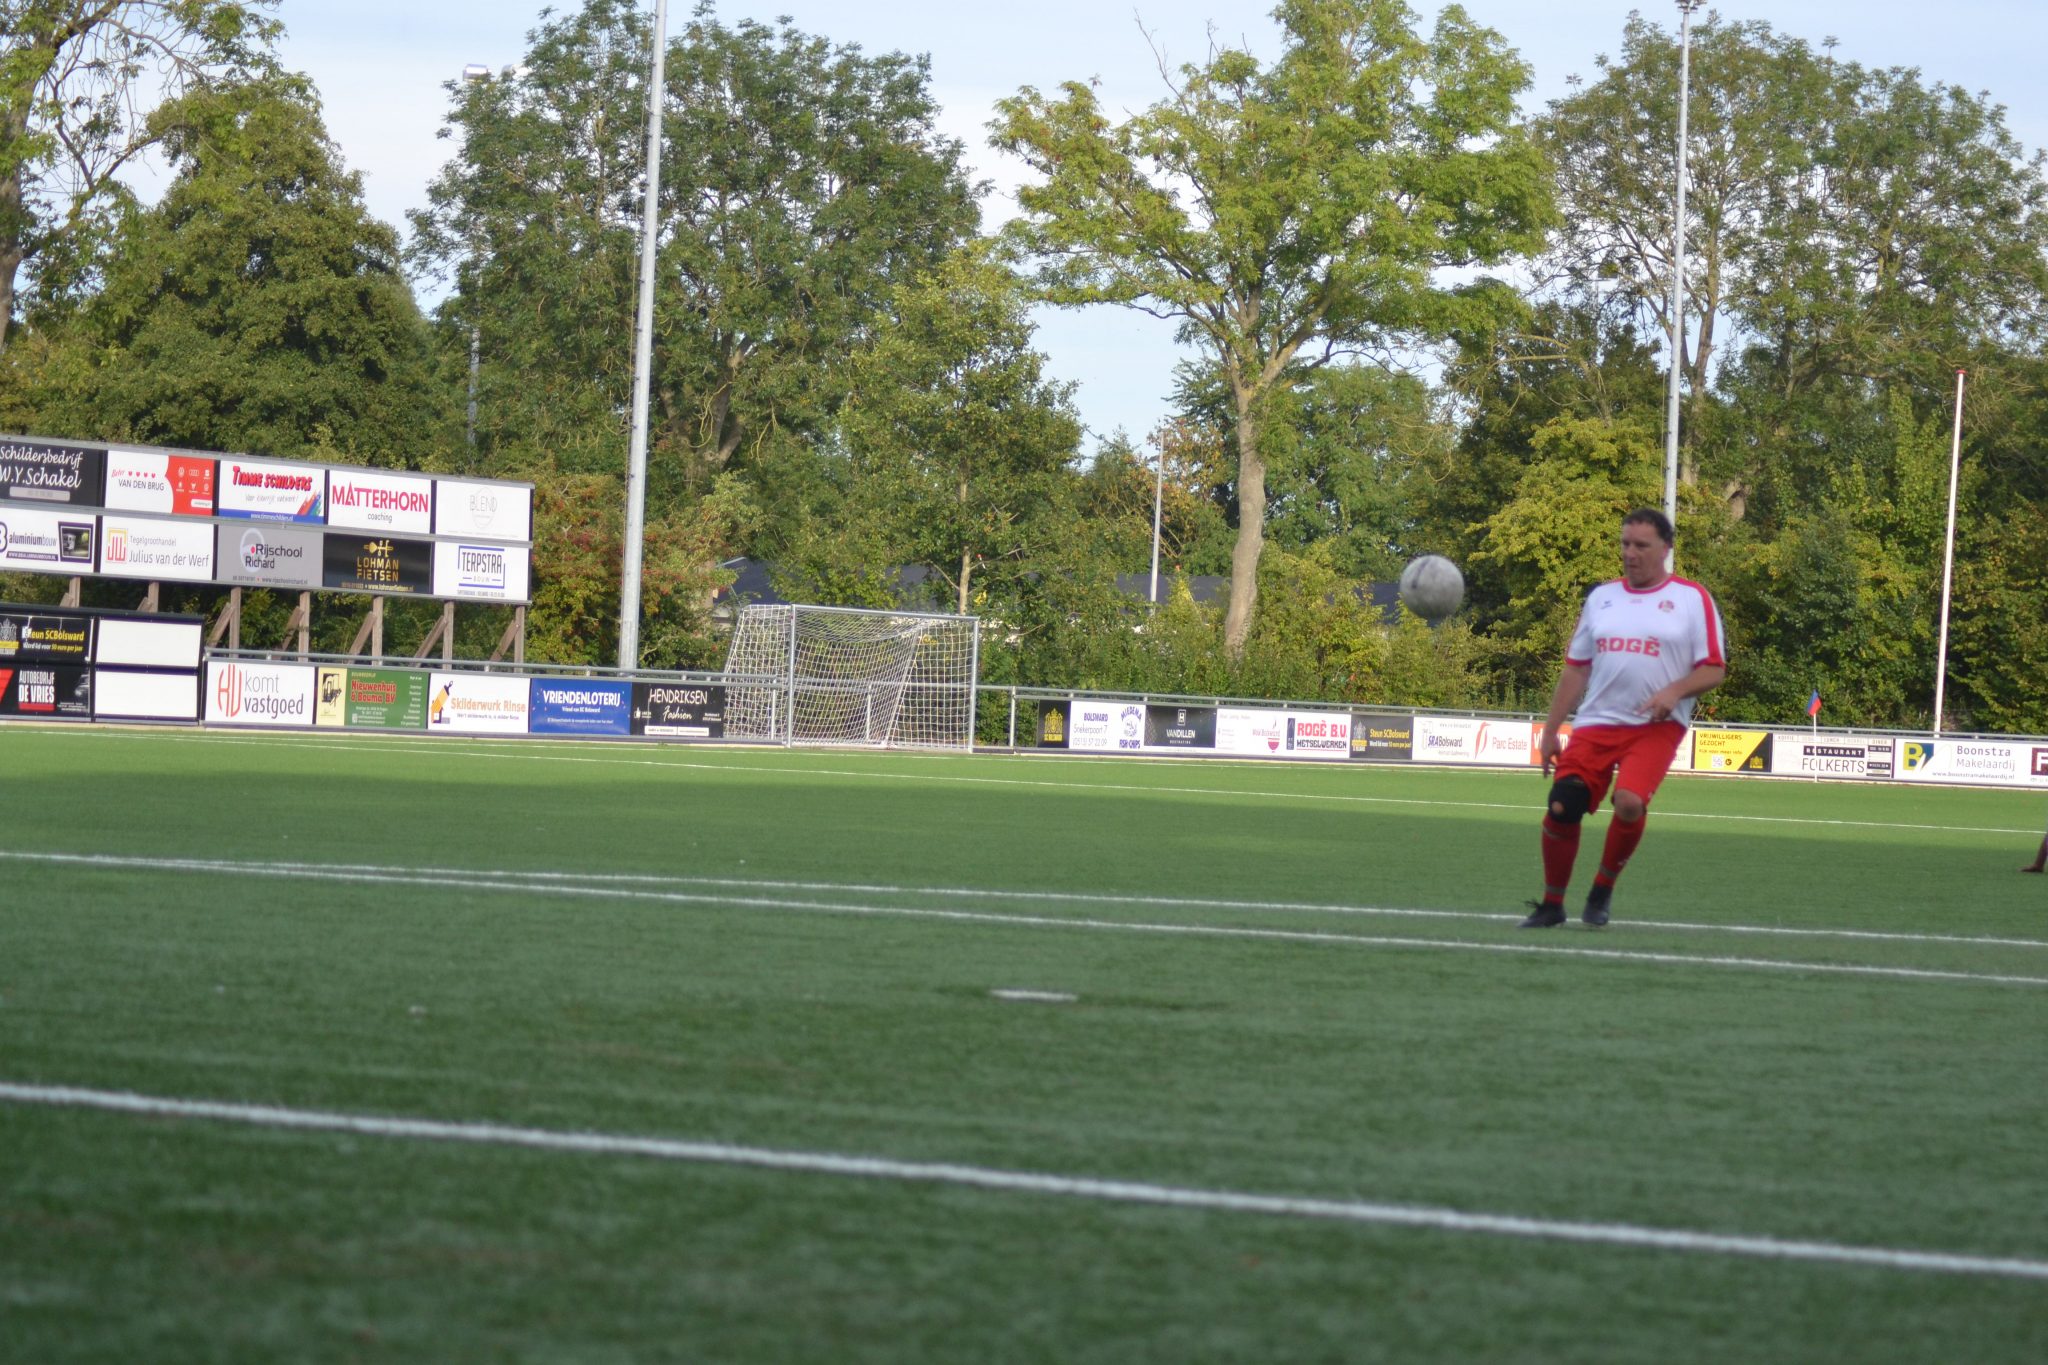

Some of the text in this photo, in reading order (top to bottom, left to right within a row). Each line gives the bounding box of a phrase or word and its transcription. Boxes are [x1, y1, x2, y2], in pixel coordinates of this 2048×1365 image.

[0, 446, 83, 470] Schildersbedrijf
[0, 464, 82, 488] W.Y.Schakel
[233, 466, 312, 491] TIMME SCHILDERS
[118, 479, 165, 491] VAN DEN BRUG
[332, 481, 429, 512] MATTERHORN
[470, 495, 498, 512] BLEND
[368, 512, 392, 523] coaching
[9, 532, 57, 546] aluminiumbouw
[130, 536, 176, 546] Tegelgroothandel
[255, 543, 302, 558] Rijschool
[129, 549, 209, 567] Julius van der Werf
[245, 556, 275, 569] Richard
[357, 556, 399, 569] LOHMAN
[462, 552, 502, 573] TERPSTRA
[357, 569, 398, 582] FIETSEN
[45, 630, 84, 641] SCBolsward
[20, 670, 54, 684] AUTOBEDRIJF
[245, 670, 279, 693] komt
[19, 684, 55, 703] DE VRIES
[351, 681, 396, 692] Nieuwenhuis
[358, 692, 383, 703] Bouma
[385, 693, 396, 704] BV
[543, 690, 620, 707] VRIENDENLOTERIJ
[649, 688, 708, 705] HENDRIKSEN
[244, 693, 304, 719] vastgoed
[451, 698, 526, 712] Skilderwurk Rinse
[663, 705, 692, 722] Fashion
[1296, 739, 1347, 749] METSELWERKEN
[1492, 736, 1506, 749] Parc
[1508, 737, 1527, 750] Estate
[1957, 745, 2011, 757] Boonstra
[1802, 758, 1865, 773] FOLKERTS
[1956, 758, 2016, 771] Makelaardij
[1932, 772, 2014, 780] www.boonstramakelaardij.nl
